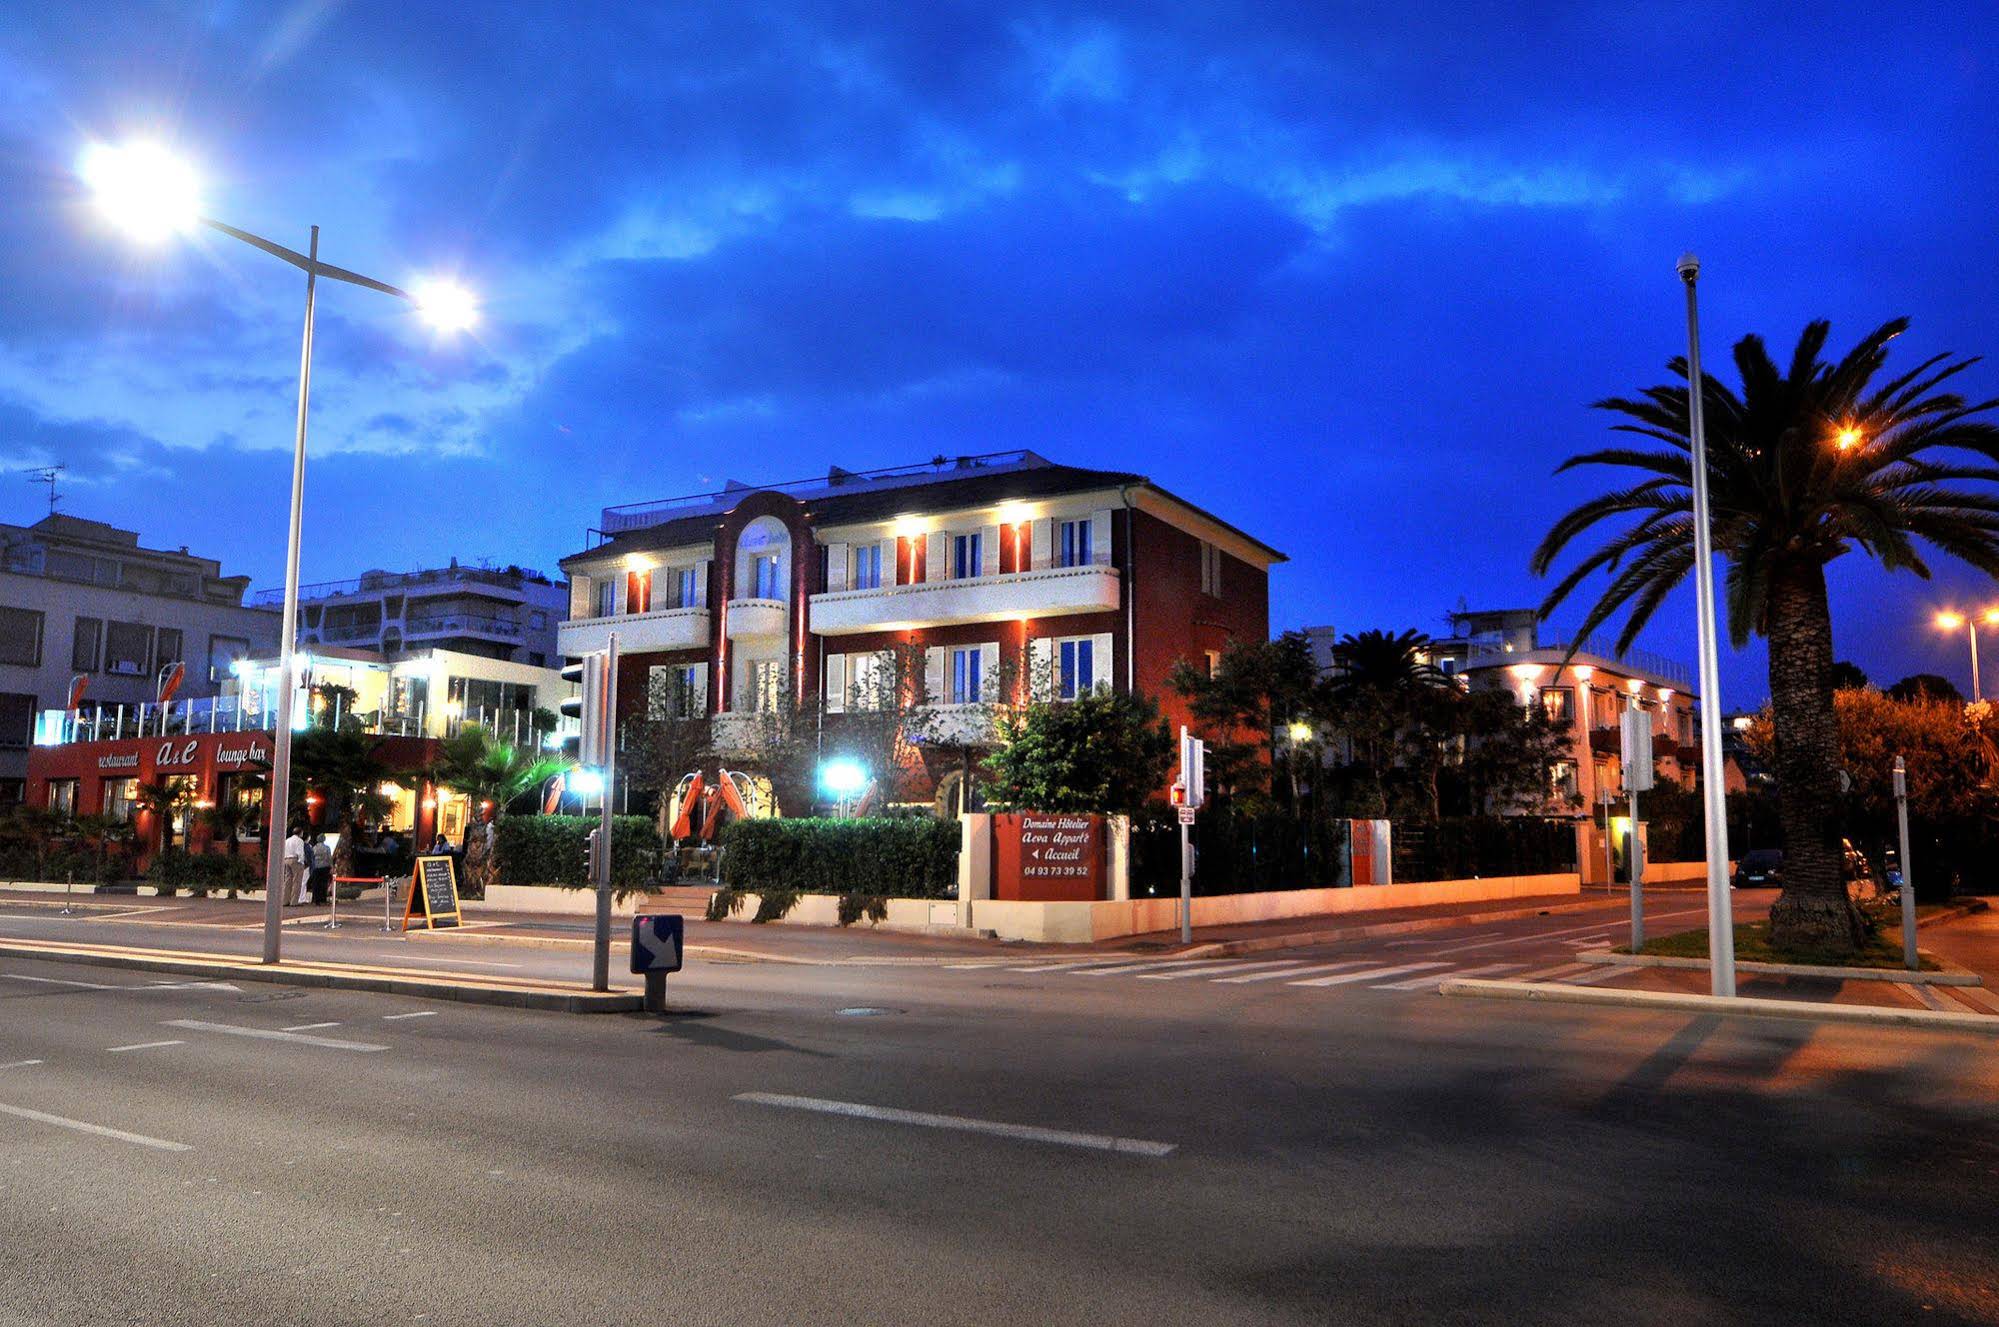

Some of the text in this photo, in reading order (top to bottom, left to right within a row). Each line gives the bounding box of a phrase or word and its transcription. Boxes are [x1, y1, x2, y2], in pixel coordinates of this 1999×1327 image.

[99, 751, 139, 769] restaurant
[216, 743, 248, 769] lounge
[248, 740, 267, 761] bar
[1022, 817, 1057, 829] Domaine
[1044, 847, 1080, 860] Accueil
[1024, 866, 1088, 875] 04 93 73 39 52
